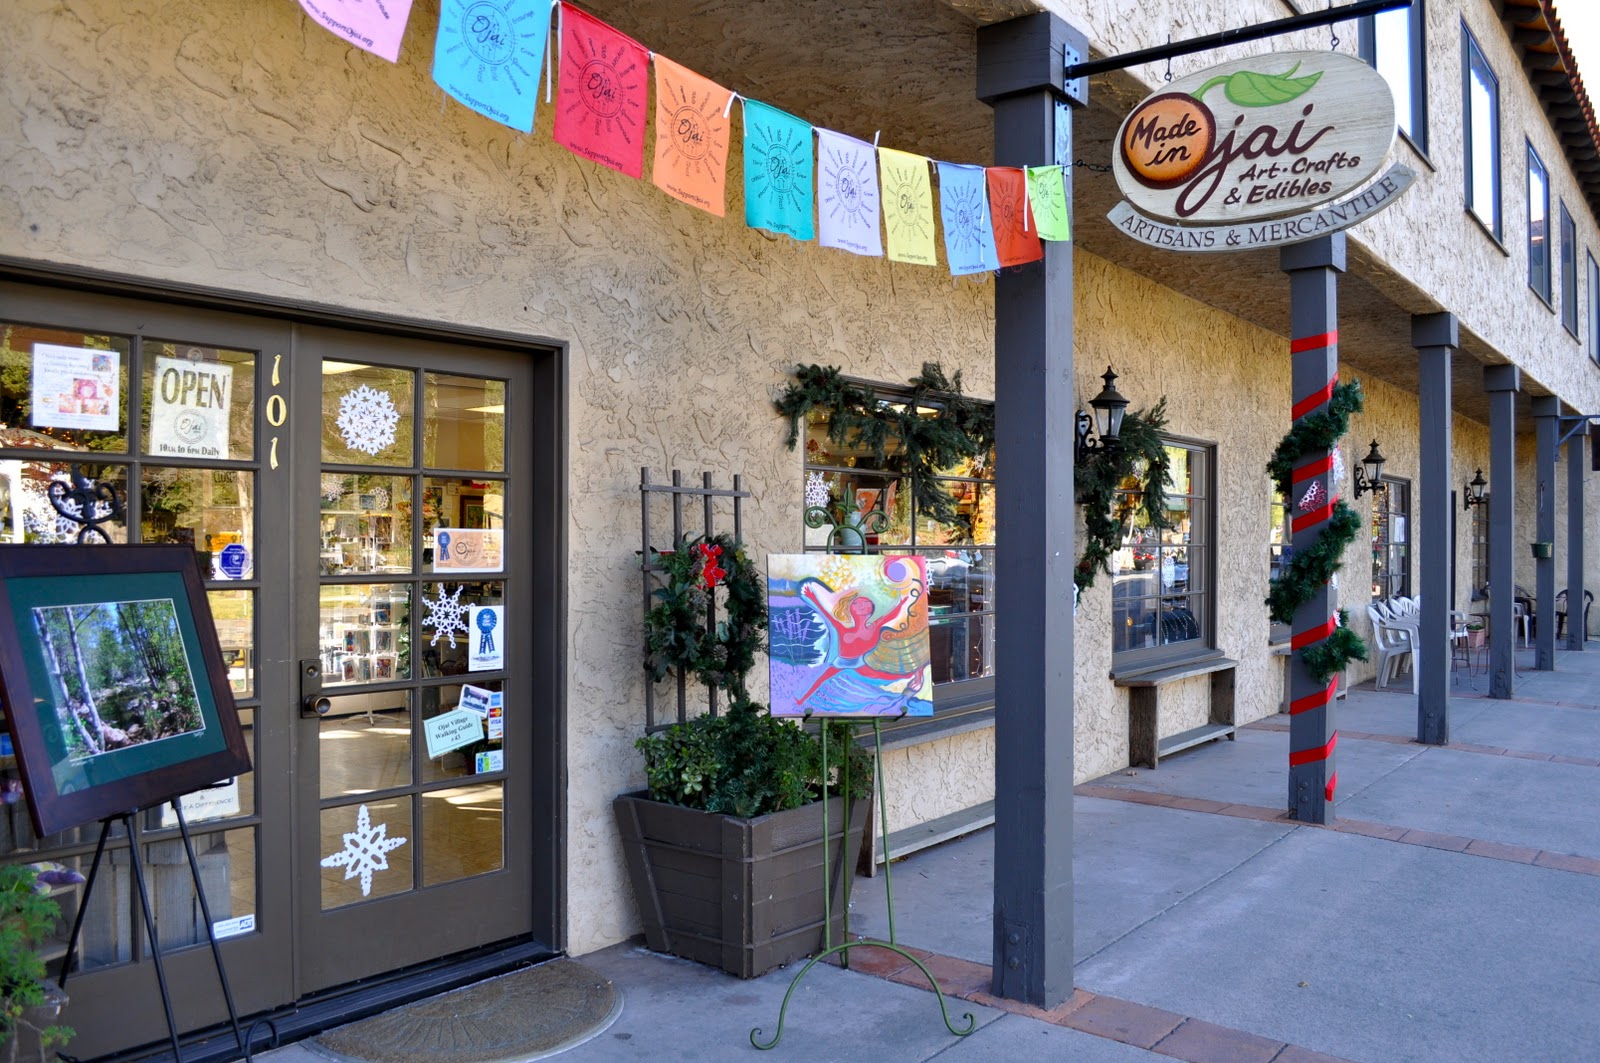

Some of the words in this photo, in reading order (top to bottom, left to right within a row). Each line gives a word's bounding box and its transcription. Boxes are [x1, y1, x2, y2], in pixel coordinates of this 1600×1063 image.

[471, 15, 508, 45] Ojai
[587, 72, 617, 99] Ojai
[677, 118, 705, 143] Ojai
[1129, 113, 1202, 150] Made
[1144, 142, 1192, 166] in
[1222, 188, 1242, 205] &
[1246, 177, 1333, 204] Edibles
[1119, 213, 1216, 248] ARTISANS
[1225, 229, 1242, 246] &
[1249, 175, 1400, 243] MERCANTILE
[161, 367, 227, 410] OPEN
[177, 444, 186, 454] to
[202, 446, 220, 459] Daily
[435, 728, 458, 740] Walking
[457, 721, 474, 732] Guide
[437, 722, 450, 731] Ojai
[450, 716, 469, 727] Village
